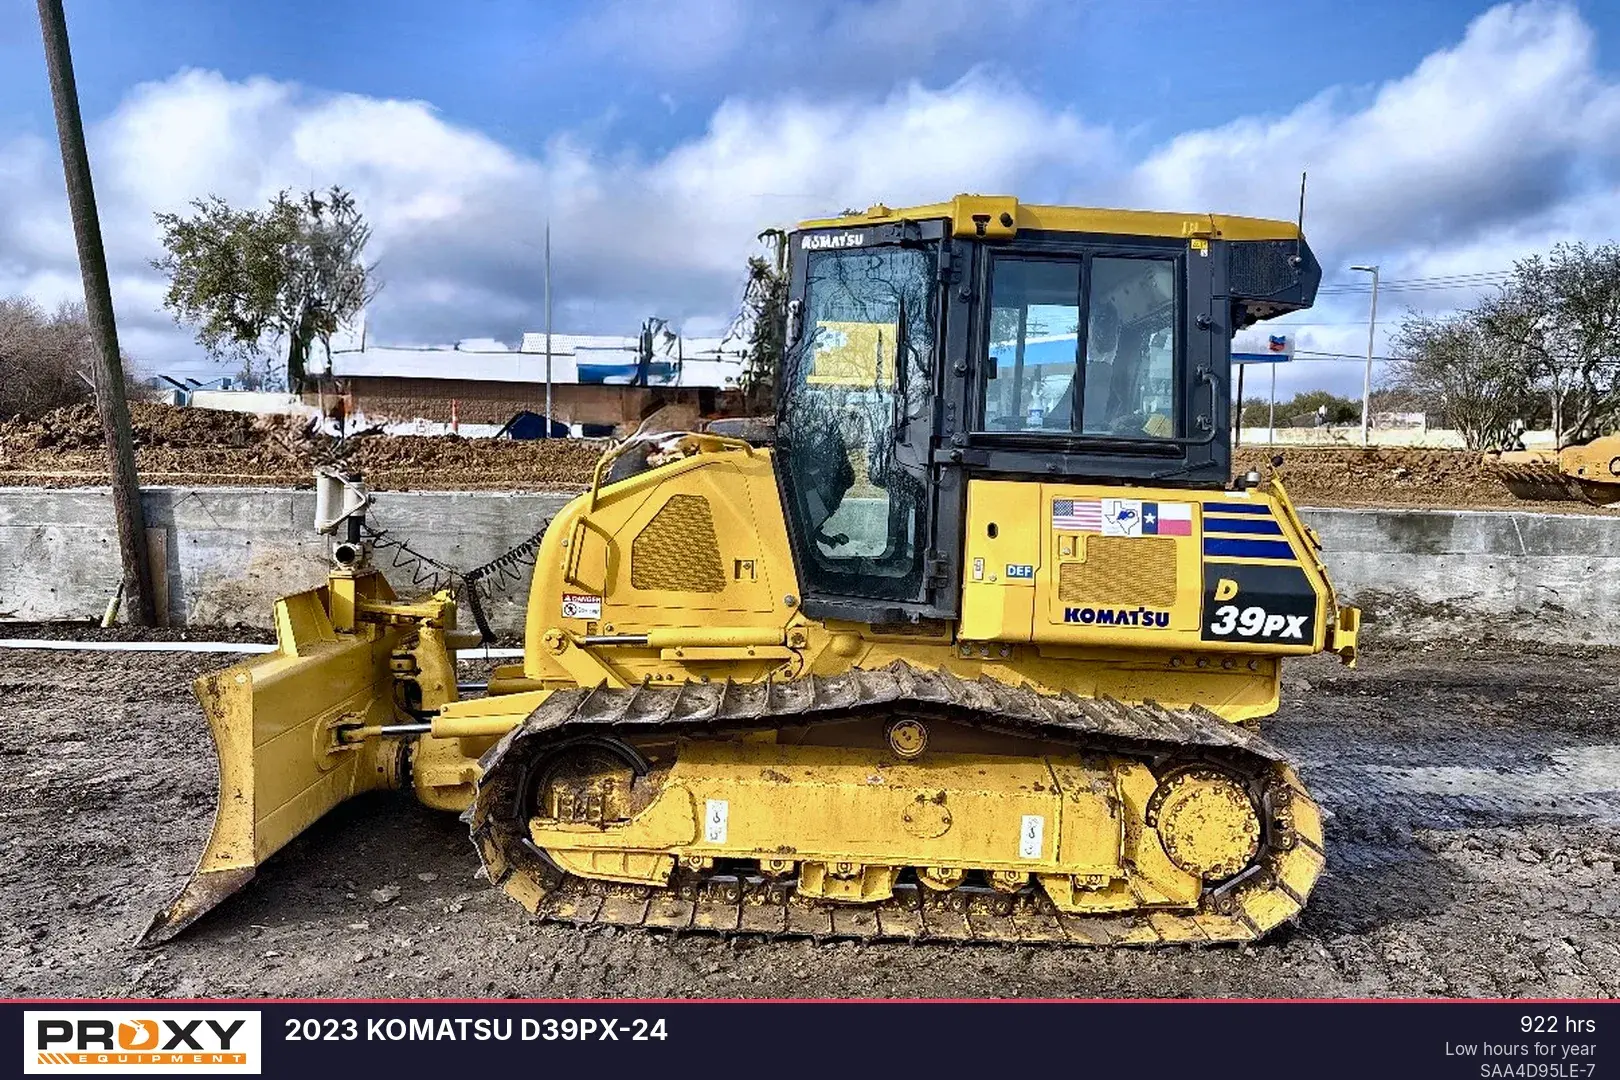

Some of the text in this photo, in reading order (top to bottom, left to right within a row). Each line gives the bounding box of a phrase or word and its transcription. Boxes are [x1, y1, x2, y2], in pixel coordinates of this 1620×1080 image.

[1008, 565, 1031, 577] DEF
[1214, 579, 1238, 601] D
[1064, 606, 1169, 627] KOMATSU
[1211, 606, 1308, 639] 39PX
